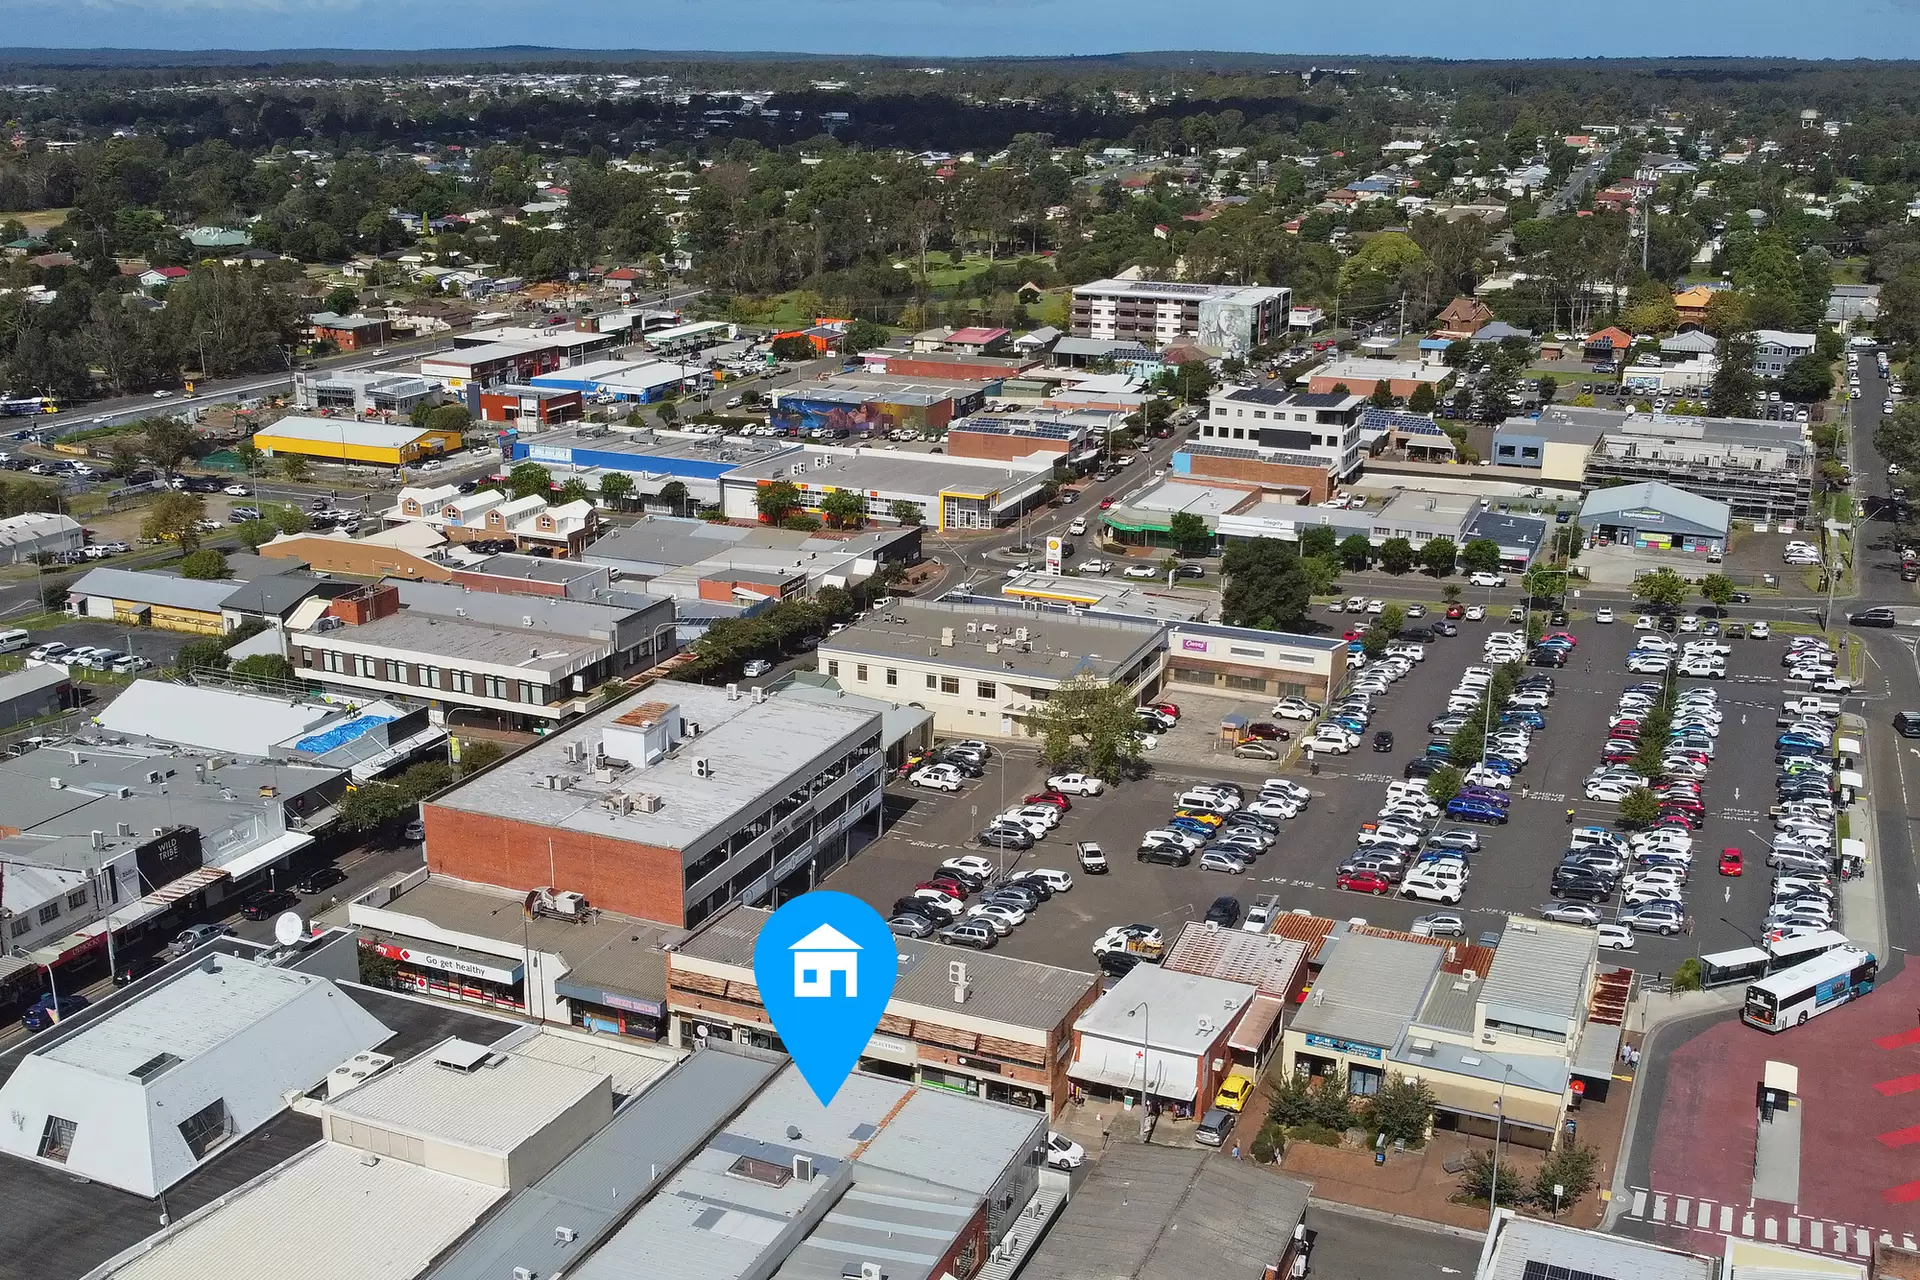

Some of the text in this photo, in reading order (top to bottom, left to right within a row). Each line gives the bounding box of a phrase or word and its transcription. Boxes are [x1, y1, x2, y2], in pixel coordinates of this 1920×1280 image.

[1263, 519, 1283, 527] Integrity
[1186, 640, 1204, 649] Curves
[157, 838, 177, 852] WILD
[158, 845, 179, 861] TRIBE
[426, 955, 486, 977] Go get healthy
